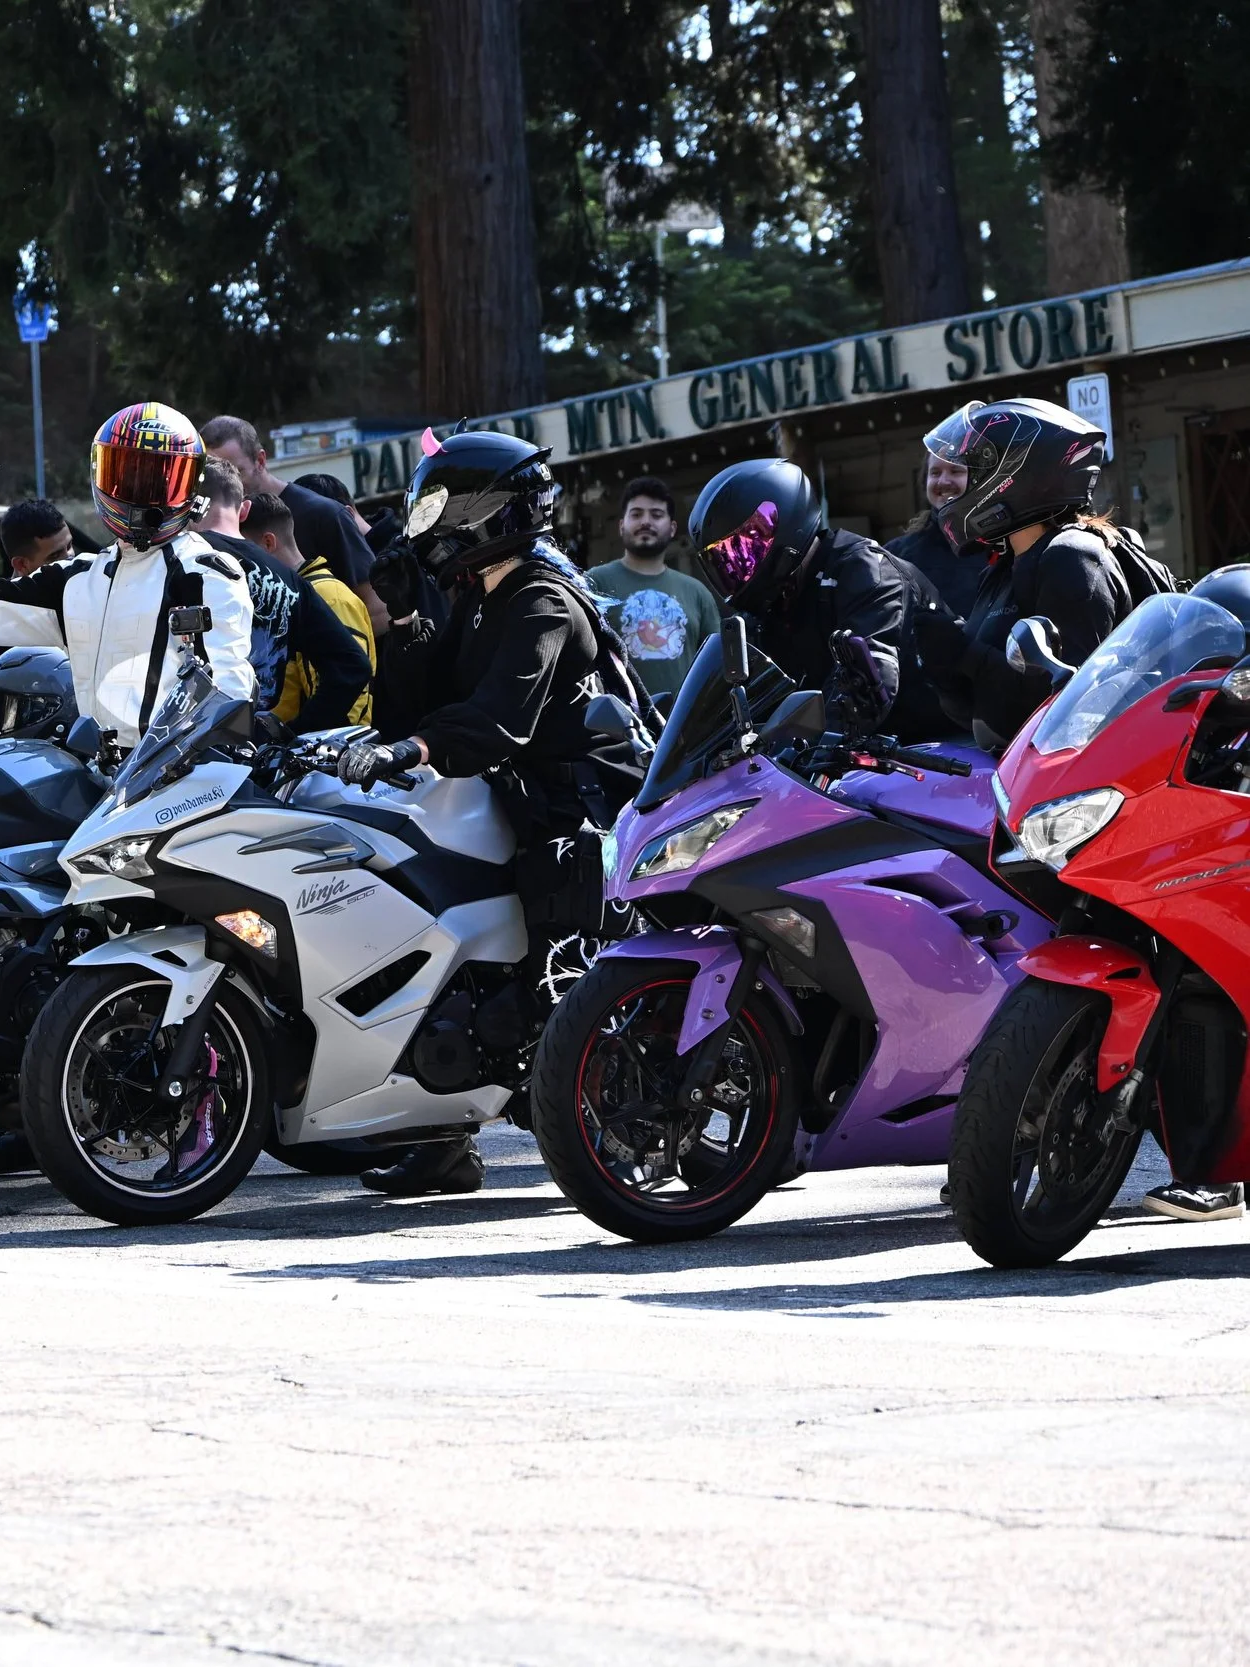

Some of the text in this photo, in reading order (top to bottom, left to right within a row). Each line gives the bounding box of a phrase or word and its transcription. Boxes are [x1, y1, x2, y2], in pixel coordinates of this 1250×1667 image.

[565, 386, 665, 456] MTN.
[688, 335, 910, 430] GENERAL
[944, 297, 1114, 382] STORE
[1077, 386, 1100, 408] NO
[296, 876, 350, 909] Ninja
[347, 888, 375, 905] 500
